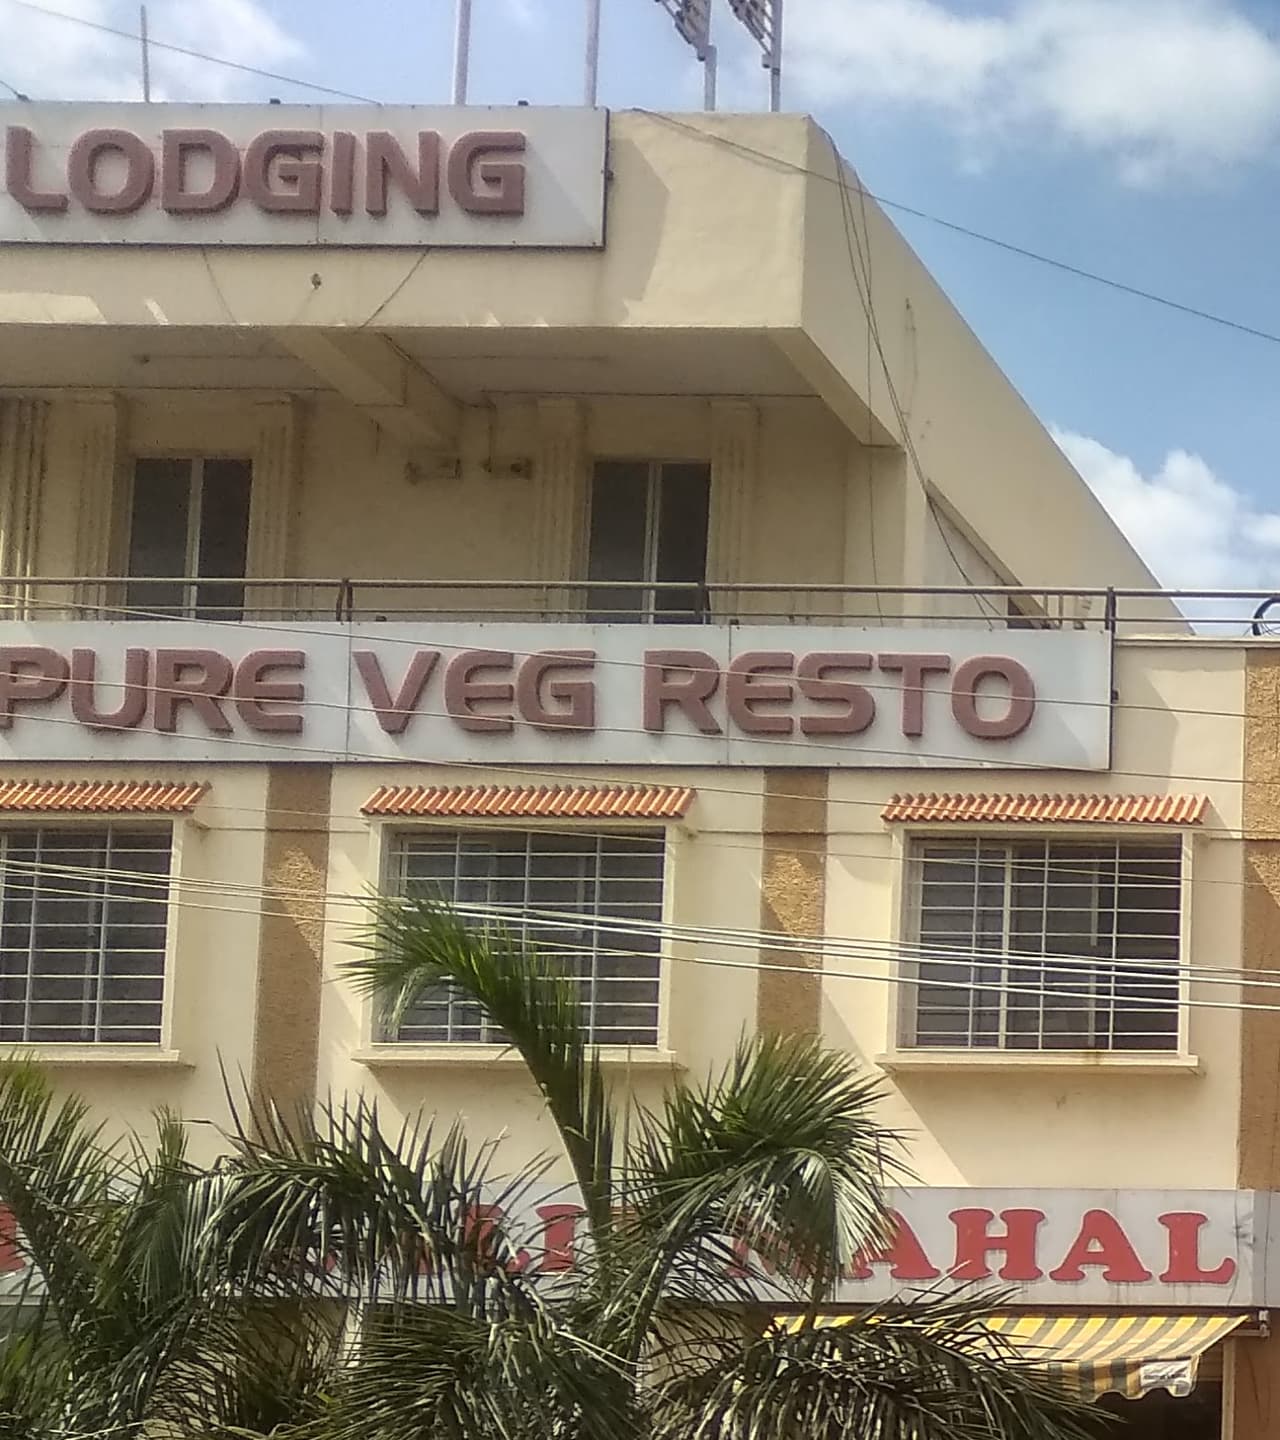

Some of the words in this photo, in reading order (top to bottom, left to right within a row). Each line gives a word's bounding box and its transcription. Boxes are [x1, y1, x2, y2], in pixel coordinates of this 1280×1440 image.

[5, 126, 527, 218] LODGING
[0, 647, 306, 735] PURE
[353, 648, 597, 734] VEG
[643, 649, 1037, 740] RESTO
